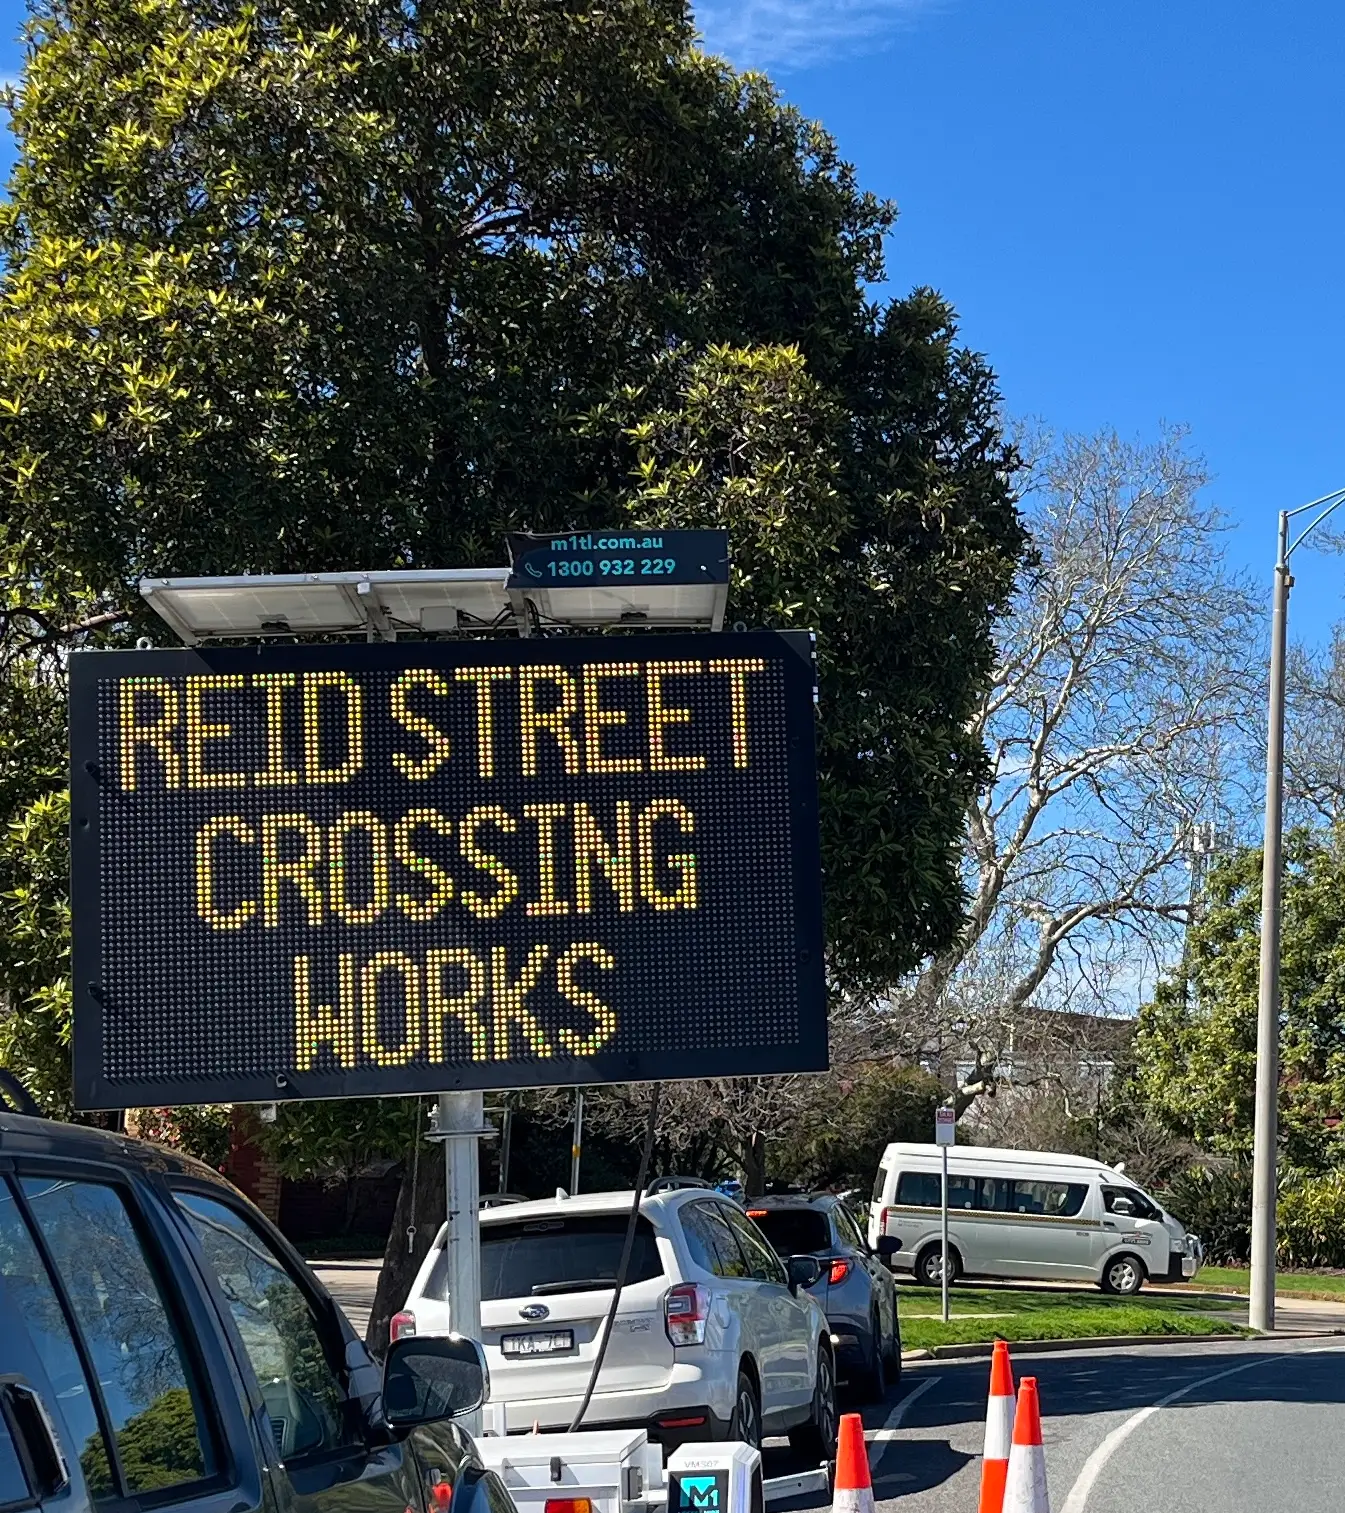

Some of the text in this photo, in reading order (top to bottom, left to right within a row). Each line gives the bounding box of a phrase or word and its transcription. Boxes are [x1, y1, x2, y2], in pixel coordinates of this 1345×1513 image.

[548, 558, 676, 577] 1300 932 229
[551, 534, 664, 551] m1tl.com.au
[118, 657, 765, 792] REID STREET
[195, 798, 698, 931] CROSSING
[294, 942, 618, 1071] WORKS
[684, 1459, 720, 1469] VMS07
